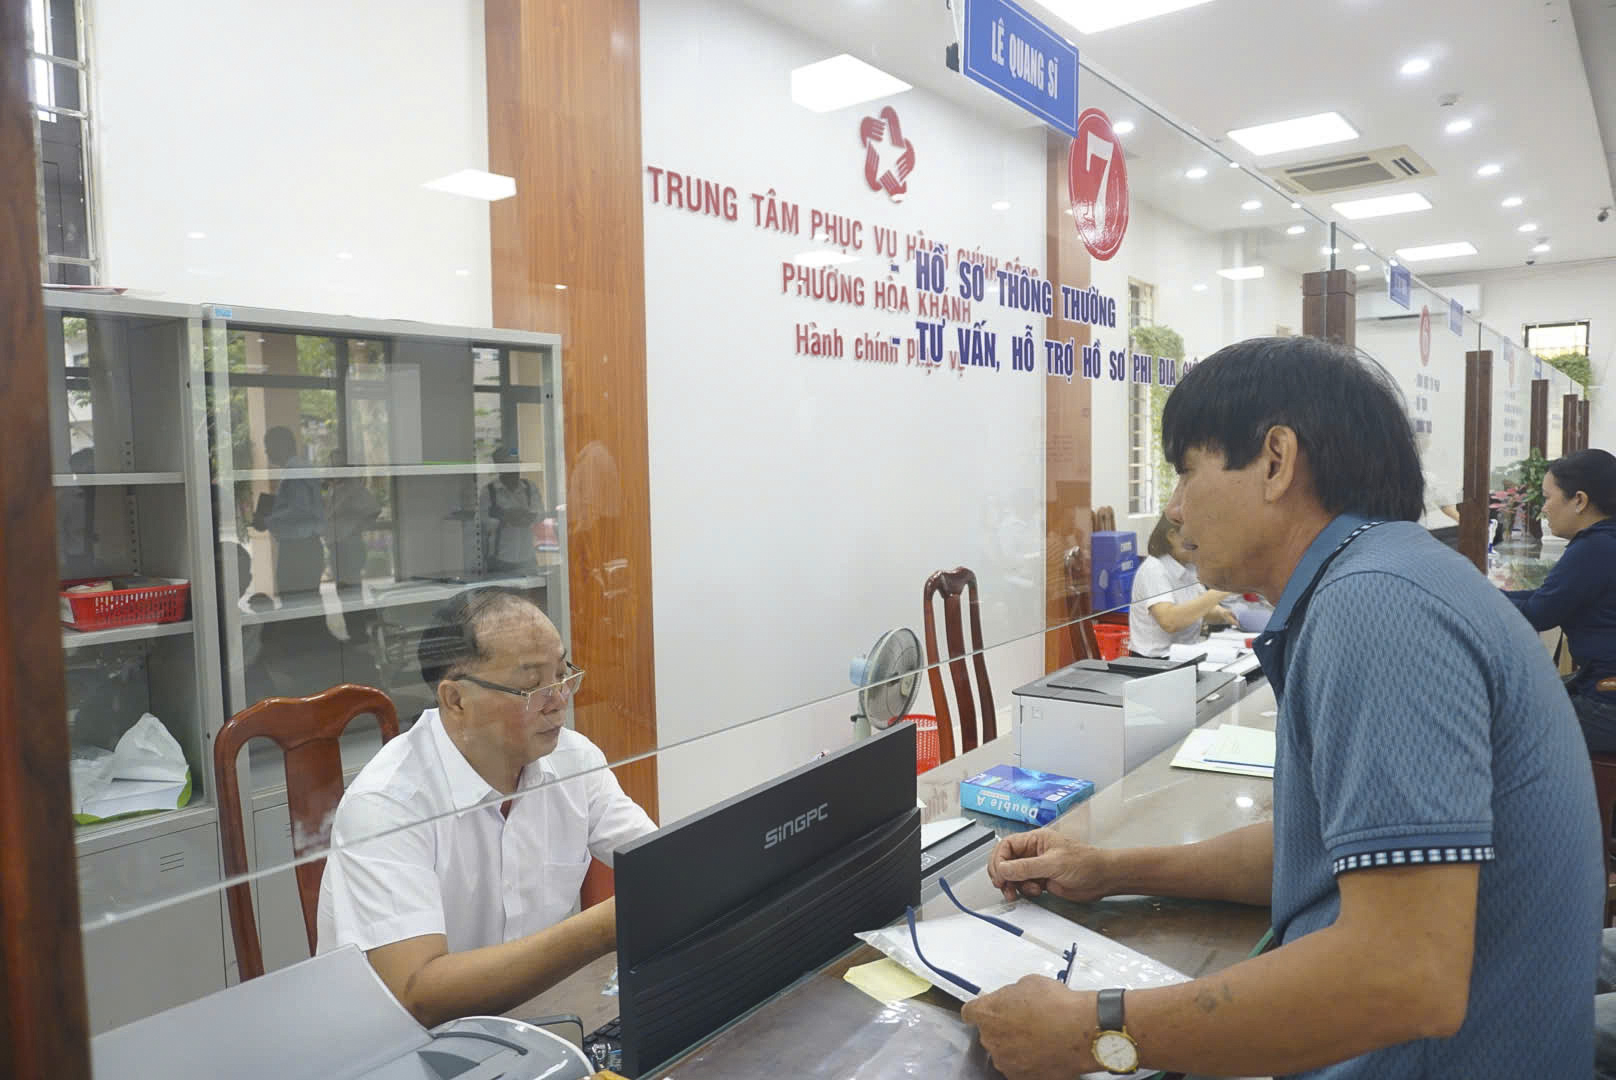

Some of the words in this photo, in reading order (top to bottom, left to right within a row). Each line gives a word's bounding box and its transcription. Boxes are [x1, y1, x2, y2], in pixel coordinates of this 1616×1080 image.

[991, 17, 1005, 67] LÊ
[1008, 32, 1045, 92] QUANG
[1086, 129, 1115, 231] 7
[647, 164, 738, 222] TRUNG
[750, 187, 800, 236] TÂM
[810, 208, 863, 255] PHỤC
[873, 224, 898, 264] VỤ
[782, 261, 865, 307] PHƯỜNG
[874, 274, 910, 312] HÒA
[917, 286, 971, 323] KHÁNH
[915, 242, 945, 295] HỒ
[958, 258, 986, 302] SƠ
[996, 269, 1052, 317] THÔNG
[1061, 284, 1117, 329] THƯỜNG
[795, 321, 844, 358] Hành
[915, 318, 946, 363] TƯ
[957, 320, 1001, 372] VẤN,
[1012, 324, 1035, 373] HỖ
[1044, 338, 1075, 384] TRỢ
[1082, 338, 1101, 380] HỒ
[1109, 348, 1126, 382] SƠ
[1133, 354, 1152, 384] PHI
[975, 795, 985, 807] A
[990, 797, 1039, 820] Double
